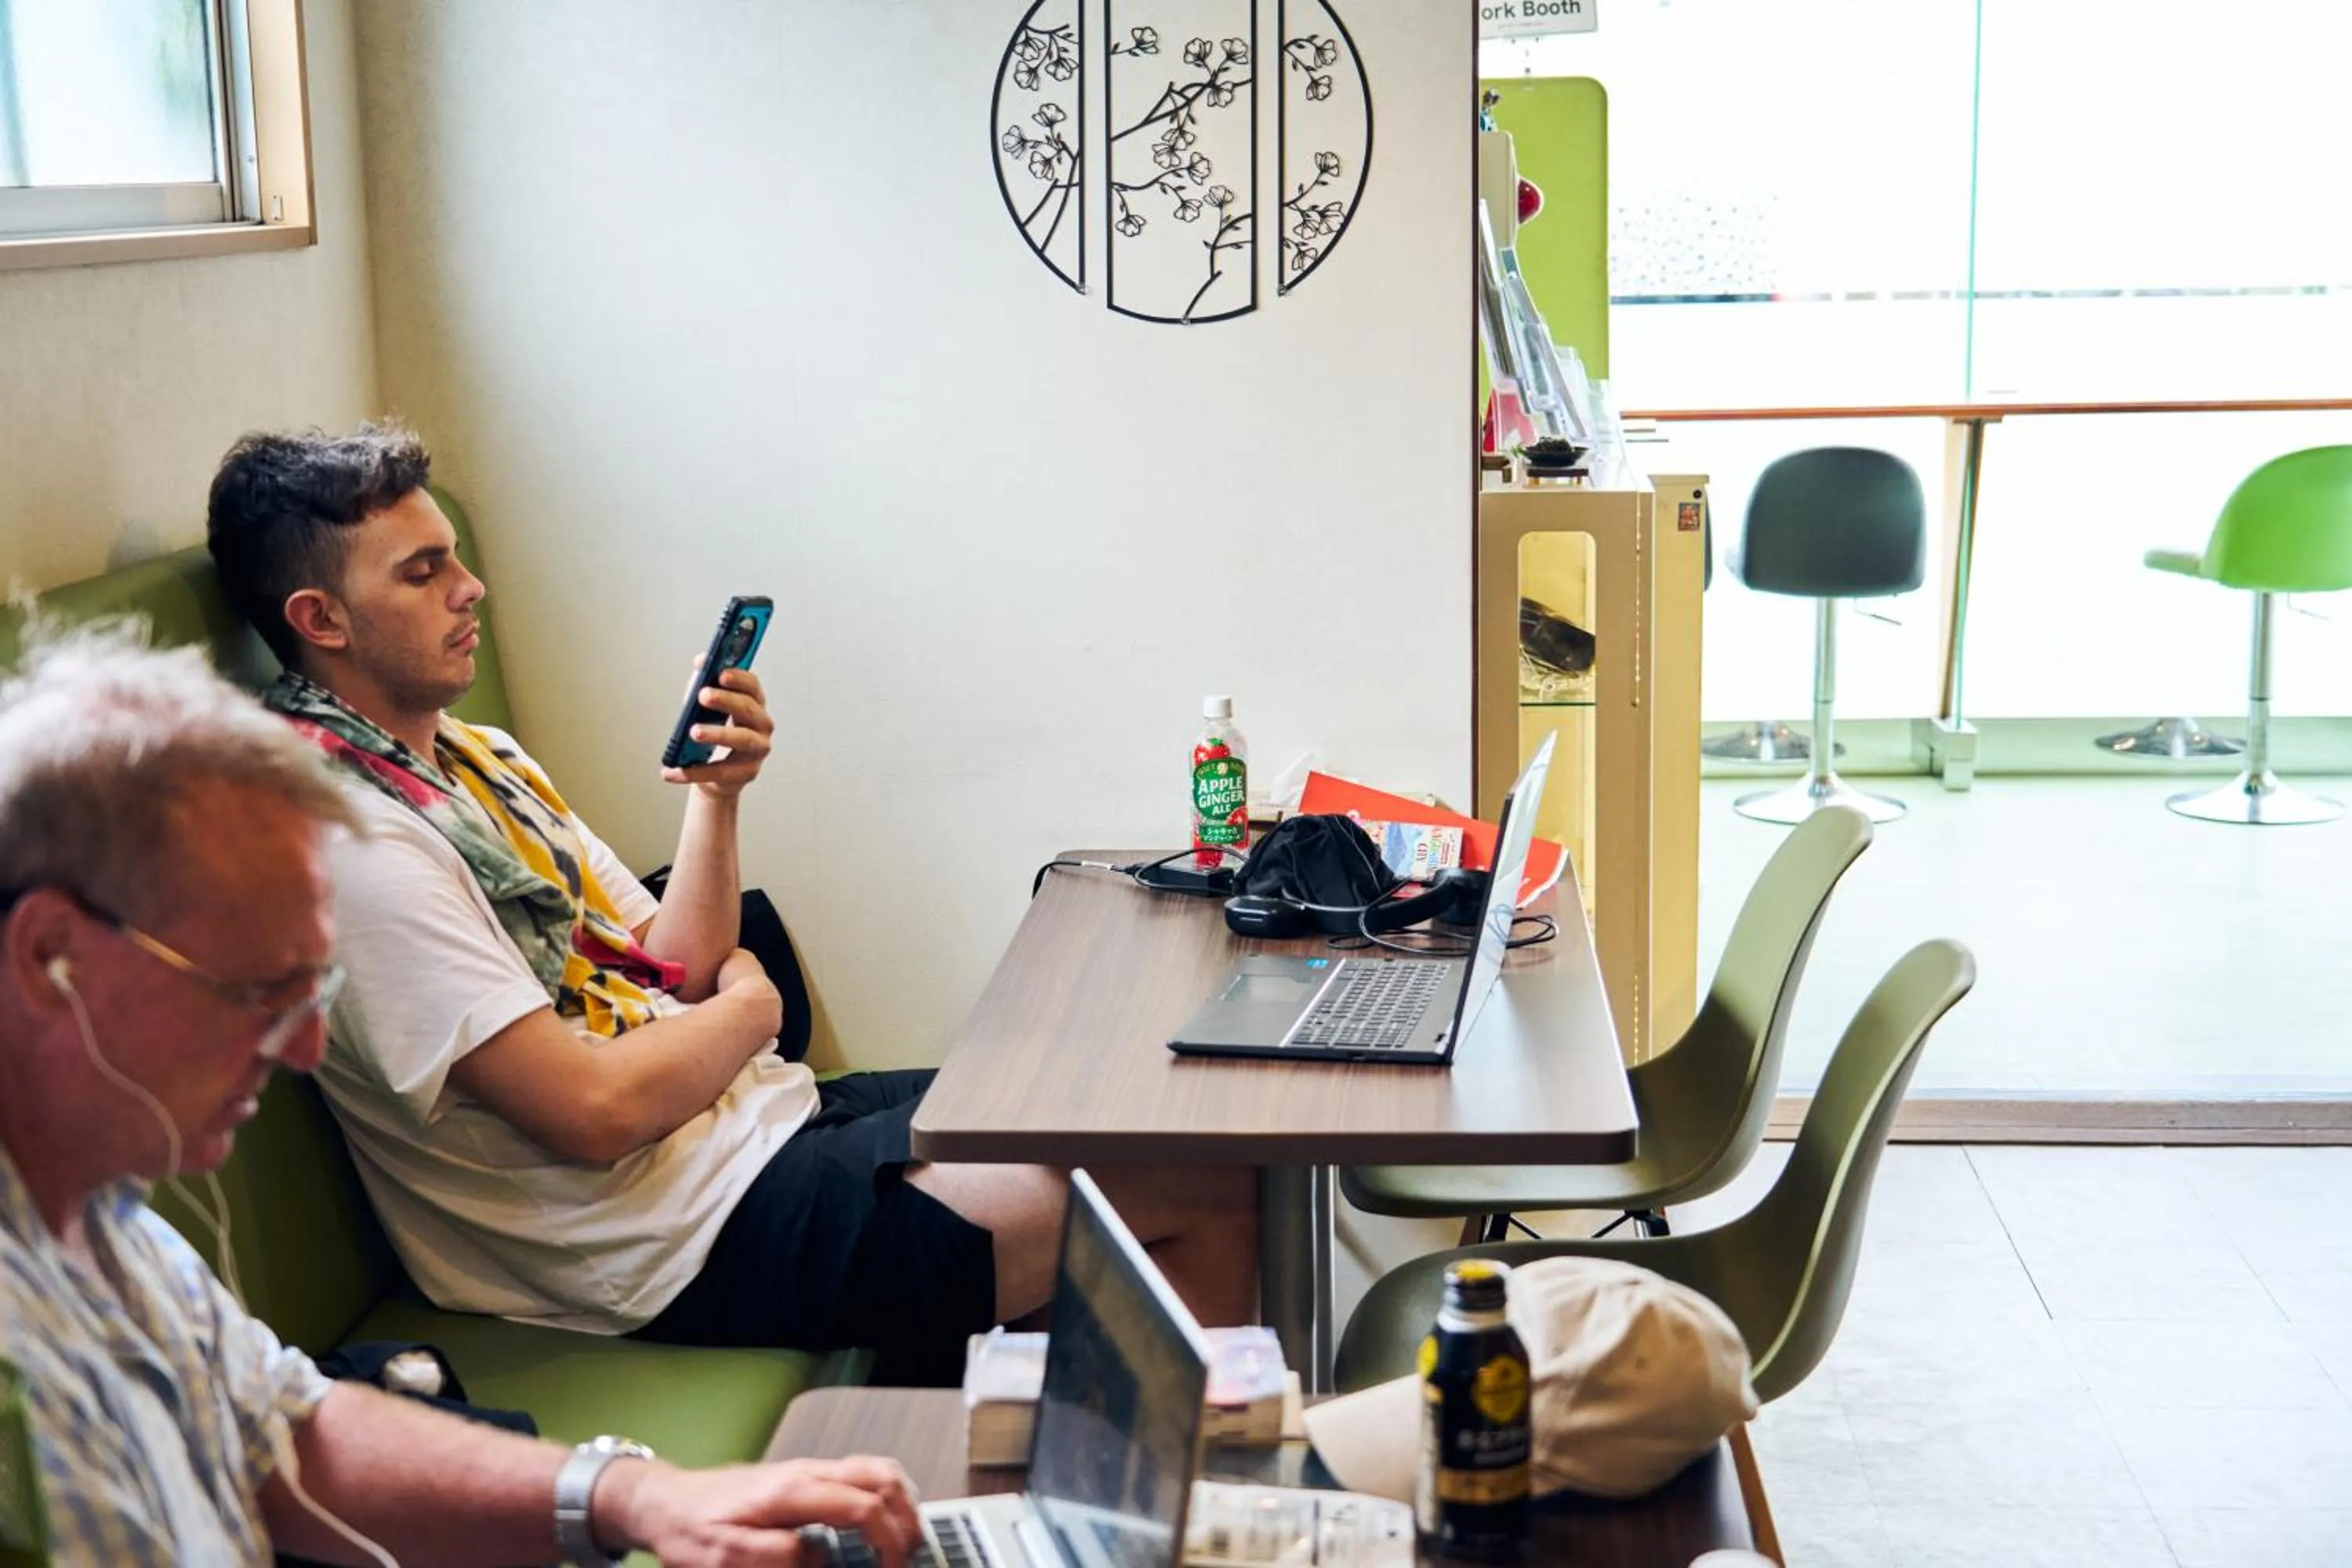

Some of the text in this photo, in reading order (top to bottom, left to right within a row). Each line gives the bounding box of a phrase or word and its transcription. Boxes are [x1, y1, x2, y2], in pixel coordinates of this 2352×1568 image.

[1481, 0, 1581, 20] ork Booth
[1198, 776, 1243, 795] APPLE
[1199, 789, 1245, 808] GINGER
[1212, 804, 1232, 815] ALE
